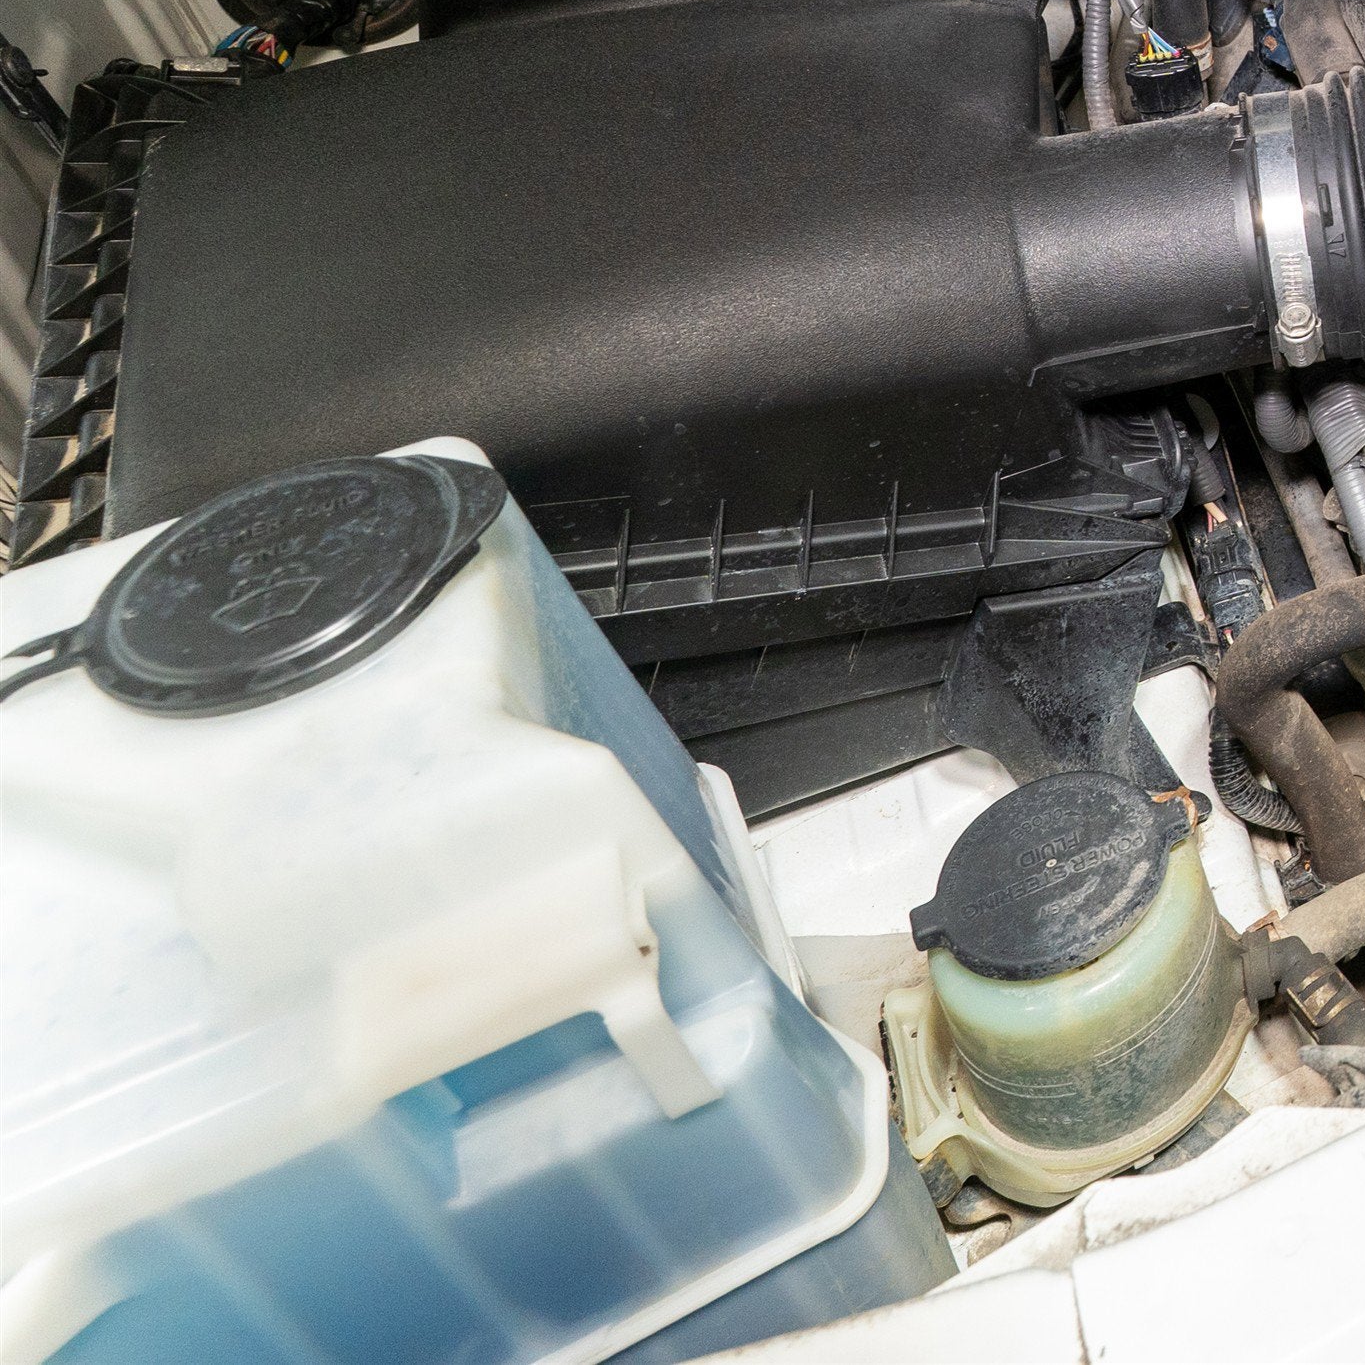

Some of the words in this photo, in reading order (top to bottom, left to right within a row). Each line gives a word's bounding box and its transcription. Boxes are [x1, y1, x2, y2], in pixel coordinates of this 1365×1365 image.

[1009, 807, 1065, 841] CLOSE
[1019, 831, 1082, 869] FLUID
[1068, 829, 1148, 874] POWER
[962, 864, 1071, 921] STEERING
